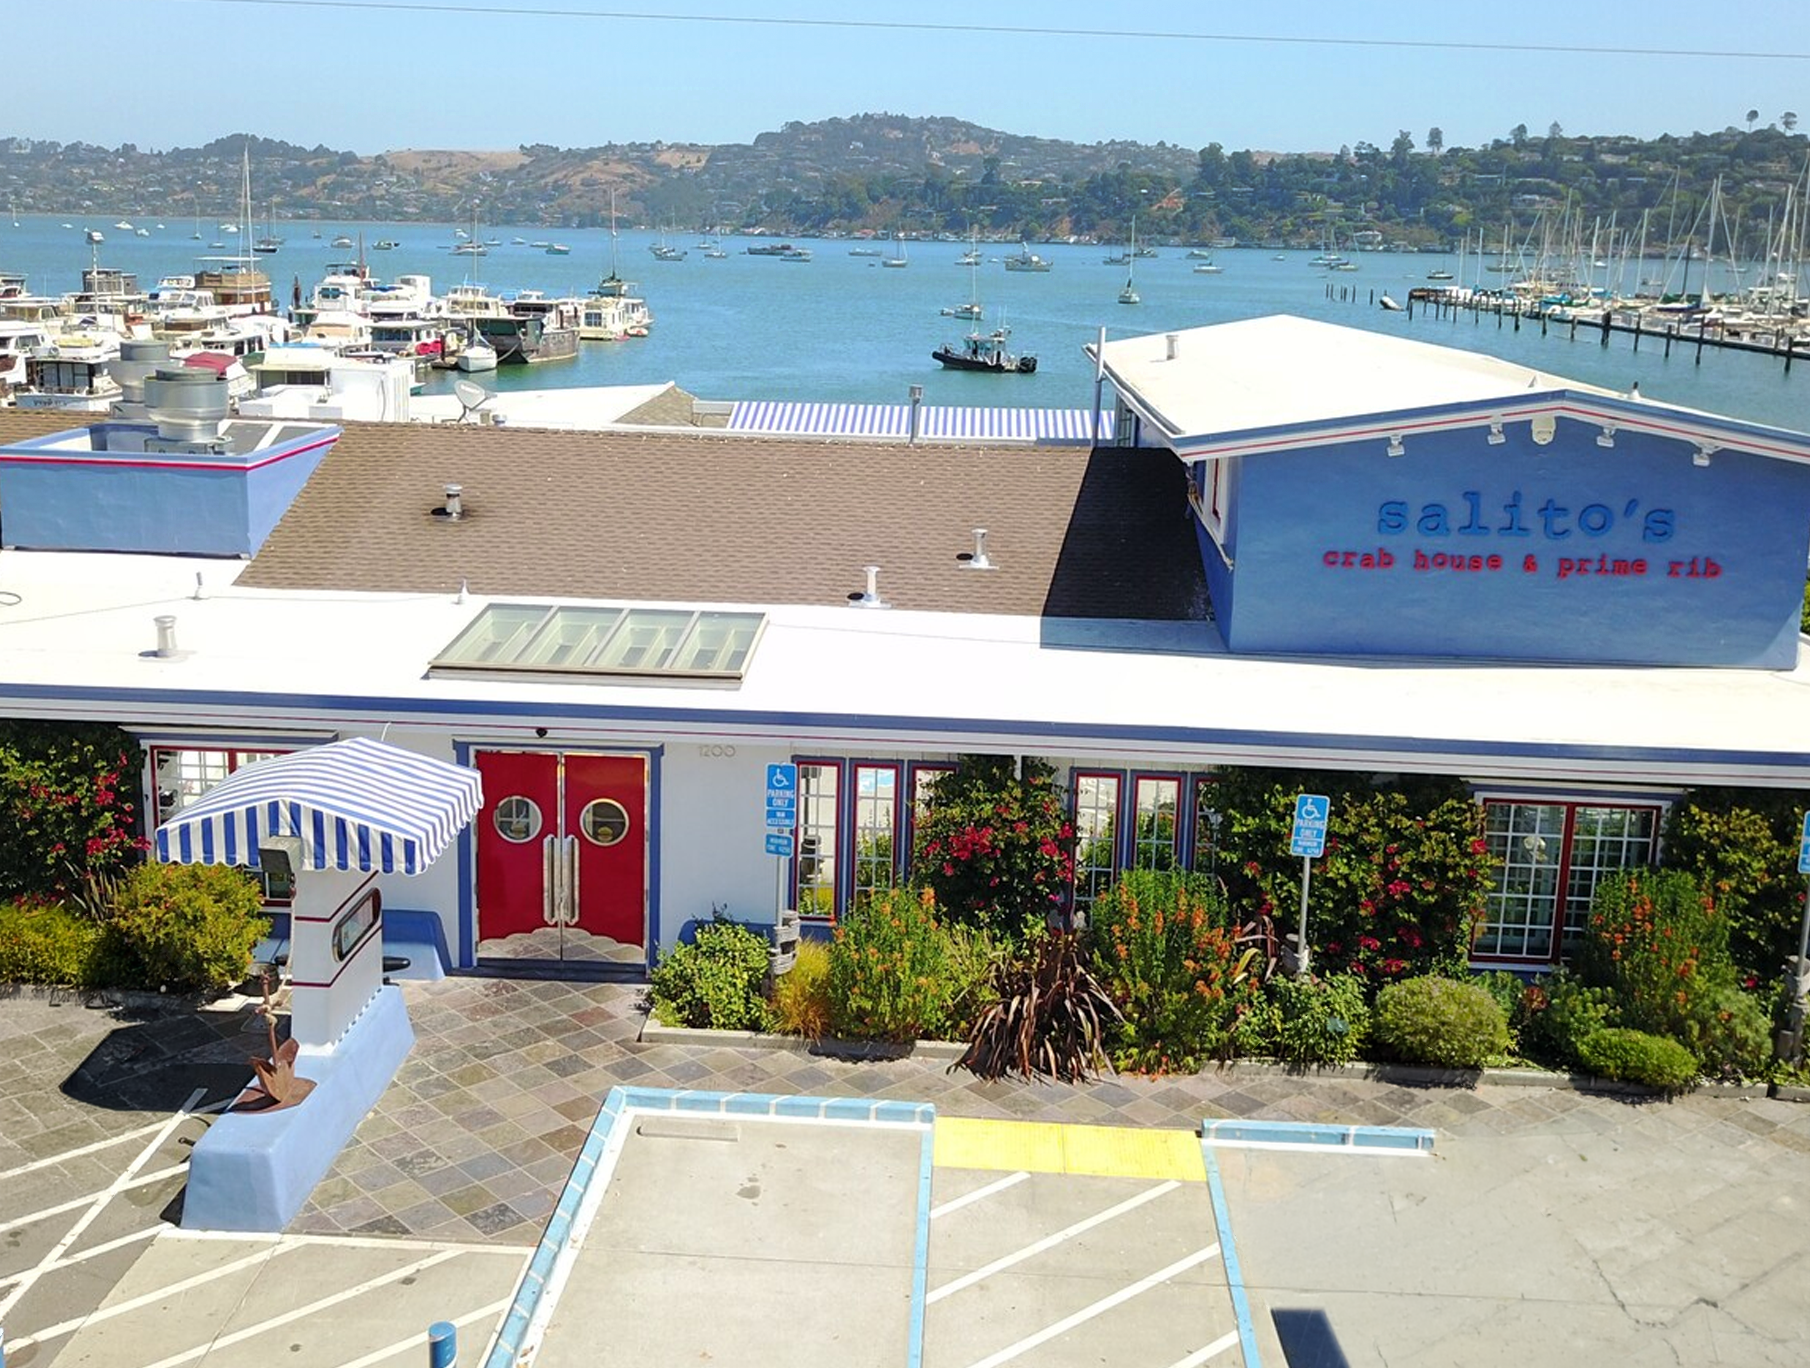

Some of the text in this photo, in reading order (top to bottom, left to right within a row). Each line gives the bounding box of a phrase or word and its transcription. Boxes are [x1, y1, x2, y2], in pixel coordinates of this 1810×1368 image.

[1378, 490, 1675, 544] salito's
[1323, 548, 1722, 579] crab house & prime rib
[767, 789, 794, 799] PARKING
[772, 798, 789, 807] ONLY
[1295, 818, 1326, 830] PARKING
